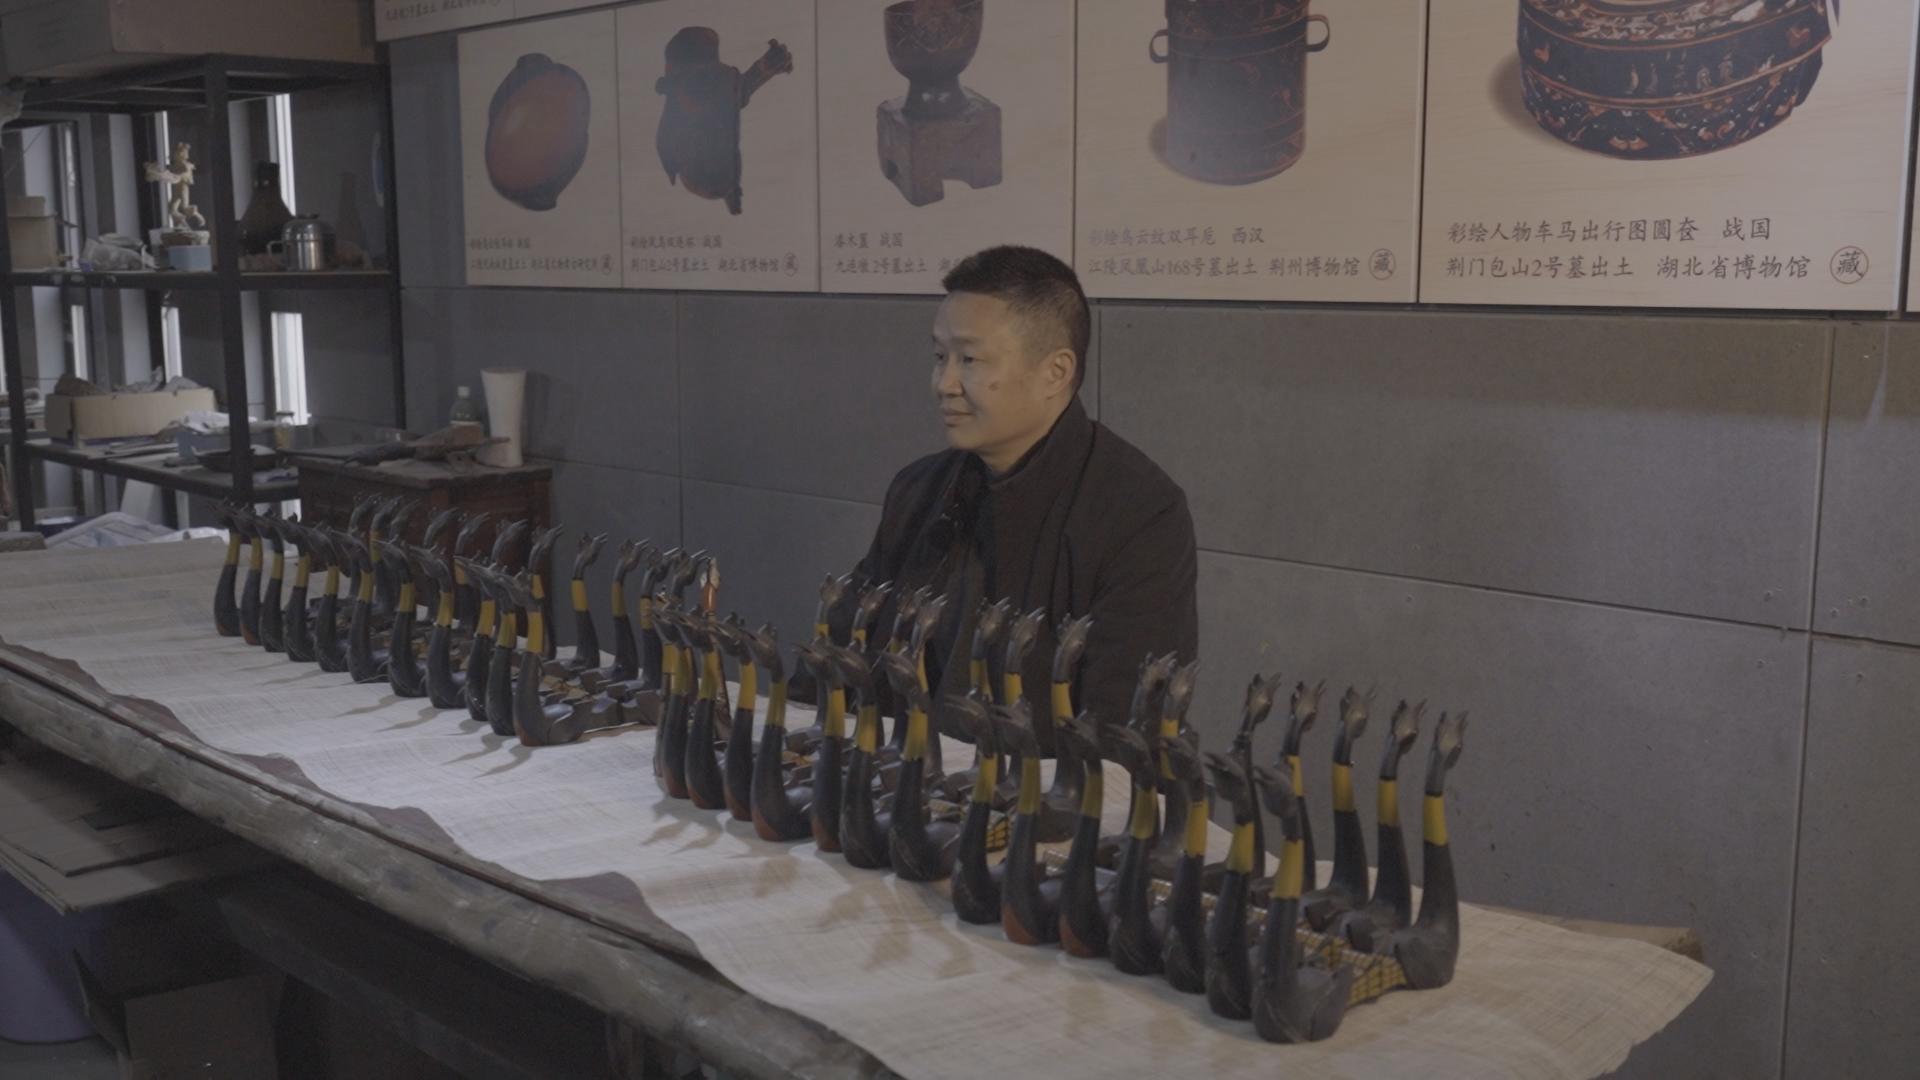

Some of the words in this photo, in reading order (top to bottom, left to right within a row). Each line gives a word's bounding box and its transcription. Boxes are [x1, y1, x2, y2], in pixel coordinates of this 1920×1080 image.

[880, 232, 904, 249] 战国
[1231, 226, 1264, 245] 西汉
[1448, 217, 1698, 244] 彩绘人物车马出行图圆奁
[1723, 217, 1770, 241] 战国
[1088, 256, 1258, 277] 江陵凤凰山168号墓出土
[1269, 256, 1361, 278] 荆州博物馆
[1371, 250, 1395, 278] 藏
[1446, 256, 1634, 279] 荆门包山2号墓出土
[1657, 254, 1811, 280] 湖北省博物馆
[1833, 248, 1866, 281] 藏
